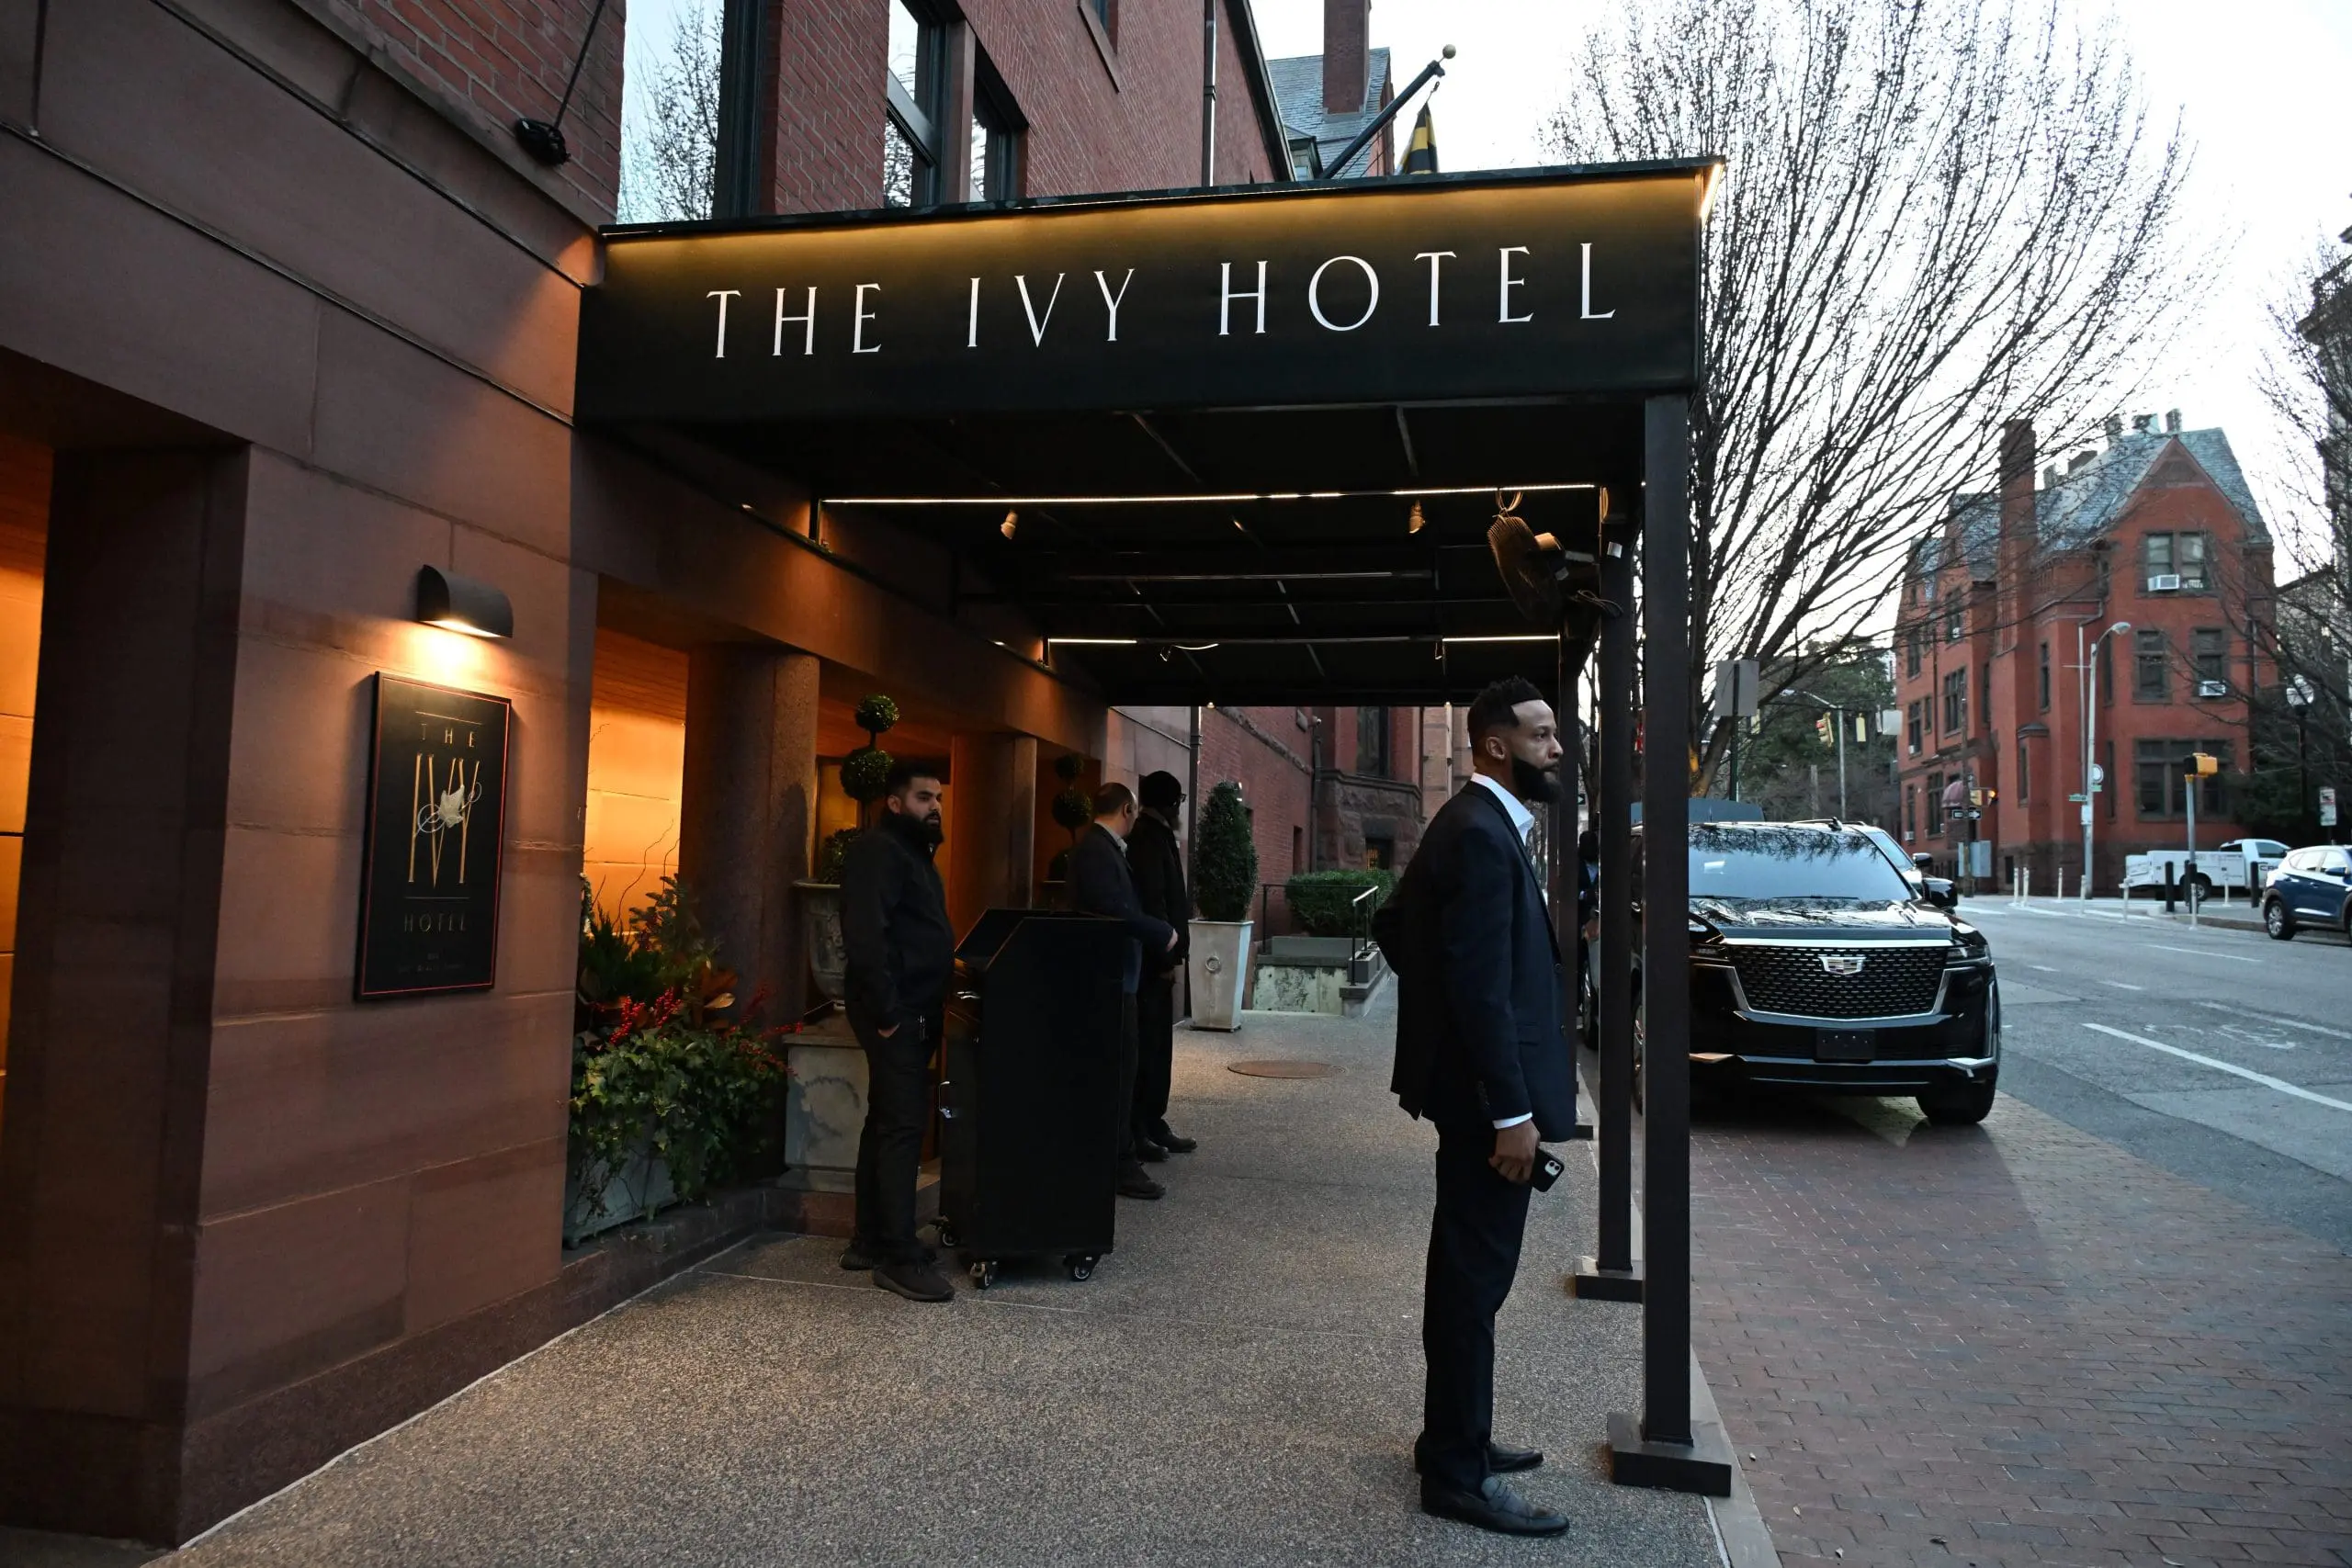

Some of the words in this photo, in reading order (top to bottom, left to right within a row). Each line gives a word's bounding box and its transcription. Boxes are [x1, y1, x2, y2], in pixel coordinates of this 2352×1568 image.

[707, 283, 882, 358] THE
[967, 268, 1136, 348] IVY
[1218, 243, 1616, 335] HOTEL
[421, 723, 475, 748] THE
[407, 752, 480, 888] IVY
